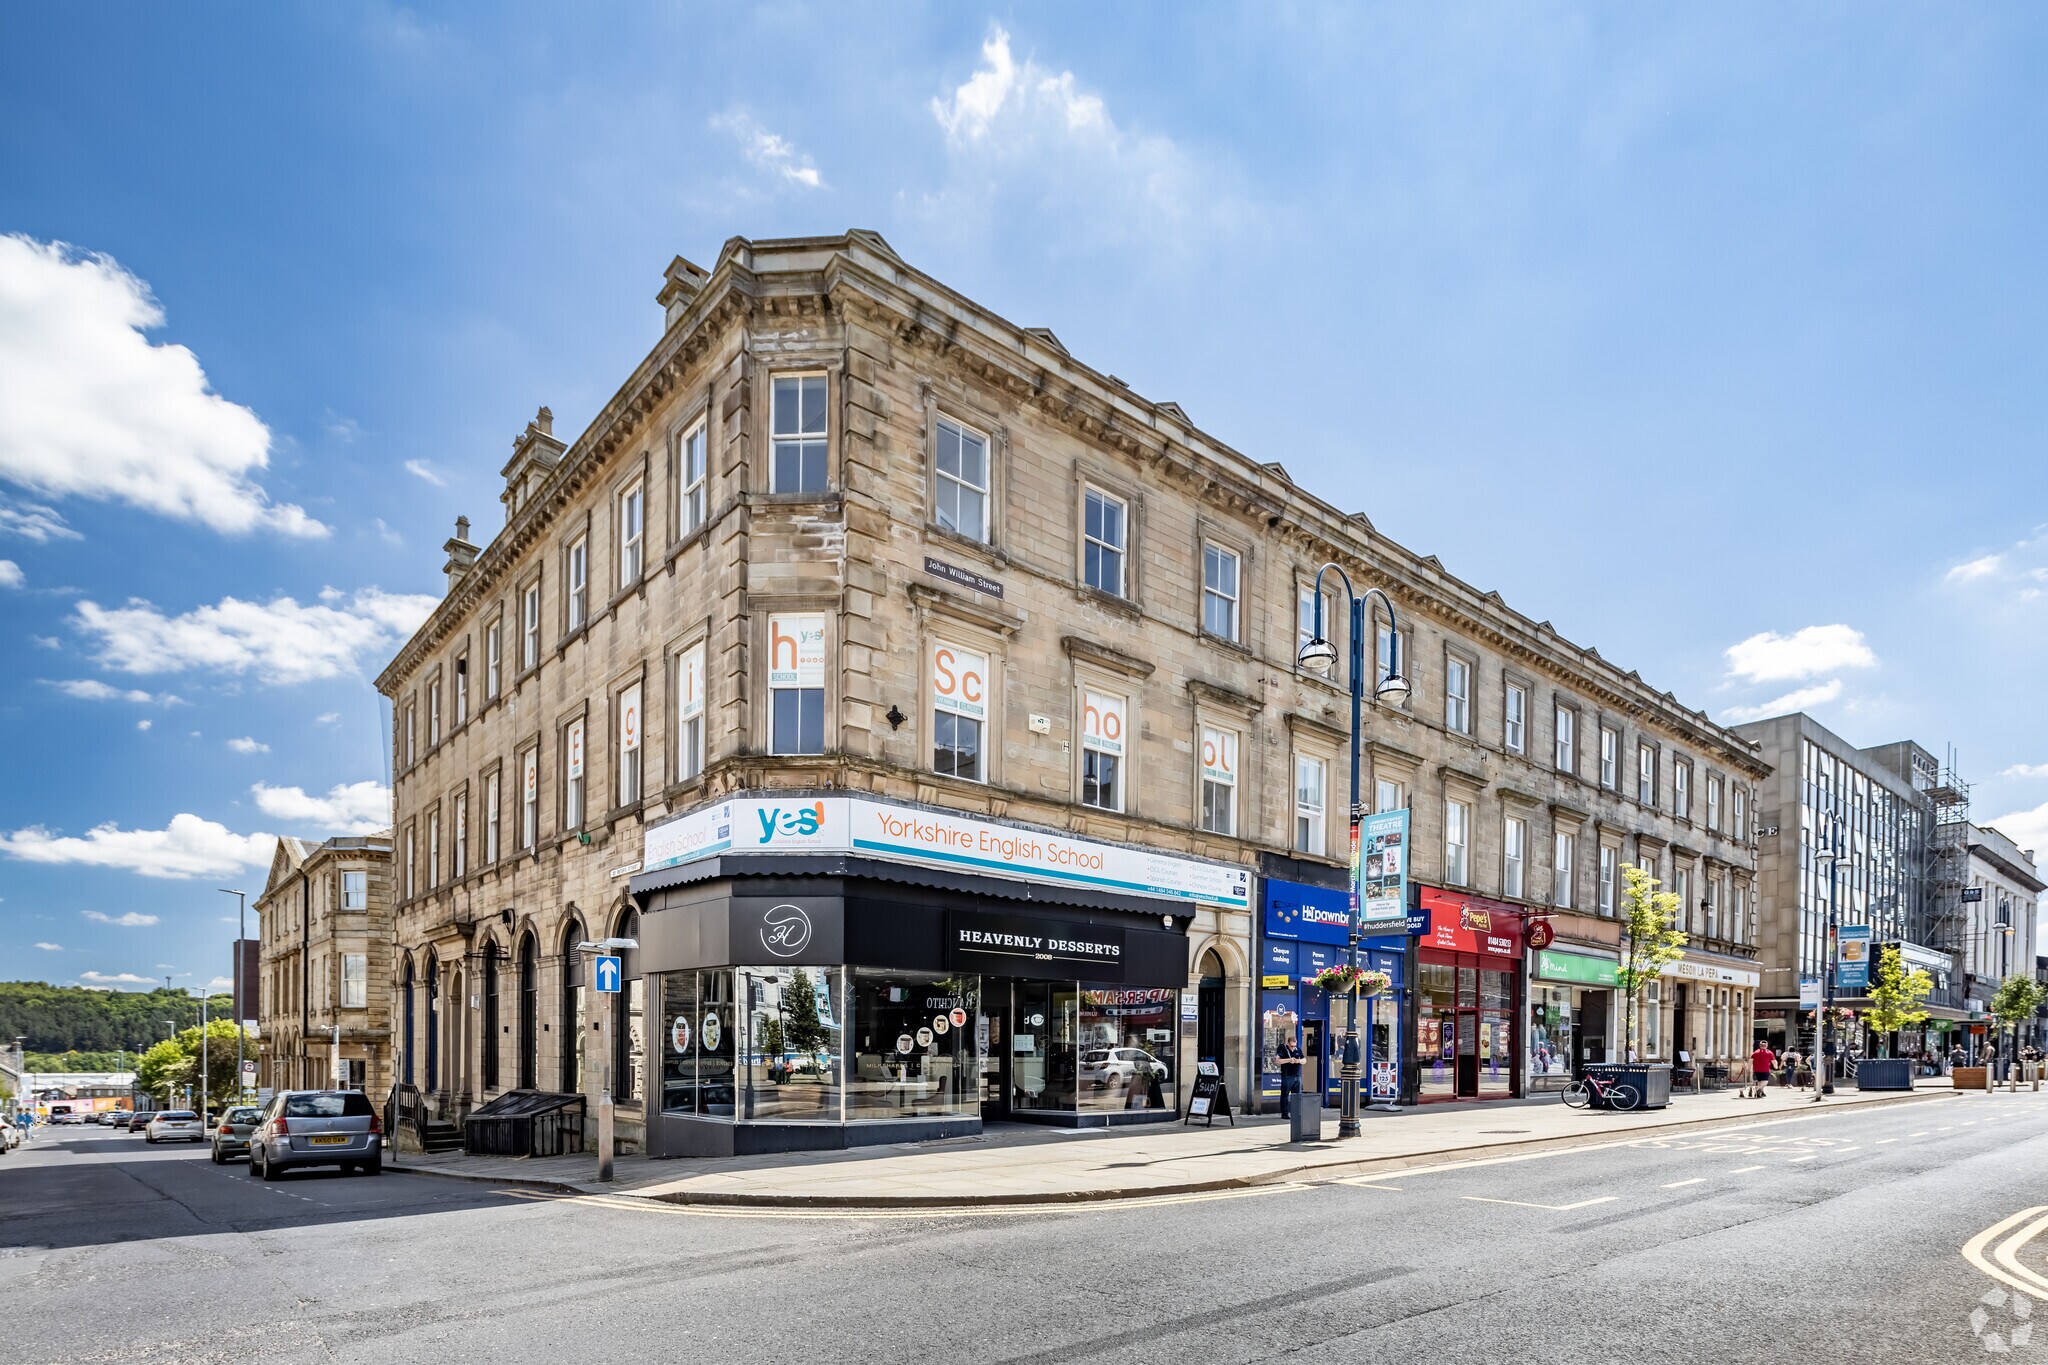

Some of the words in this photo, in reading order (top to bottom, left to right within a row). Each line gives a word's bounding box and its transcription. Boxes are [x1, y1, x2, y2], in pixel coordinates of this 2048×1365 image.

[928, 560, 946, 573] John
[949, 566, 976, 584] William
[977, 578, 1001, 593] Street
[772, 673, 797, 681] SCHOOL
[1368, 820, 1403, 832] THEATRE
[676, 824, 707, 851] School
[876, 810, 973, 848] Yorkshire
[979, 830, 1042, 860] English
[1047, 842, 1104, 871] School
[1349, 839, 1357, 857] Pride
[1363, 919, 1406, 930] #huddersfield
[1469, 911, 1487, 926] Pepe's
[959, 929, 1043, 949] HEAVENLY
[1048, 938, 1120, 956] DESSERTS
[1272, 946, 1290, 955] Cheque
[1272, 955, 1290, 964] cashing
[1677, 962, 1697, 976] MESON
[1697, 965, 1705, 977] LA
[1705, 967, 1719, 979] PEPA
[1936, 1021, 1948, 1029] PP
